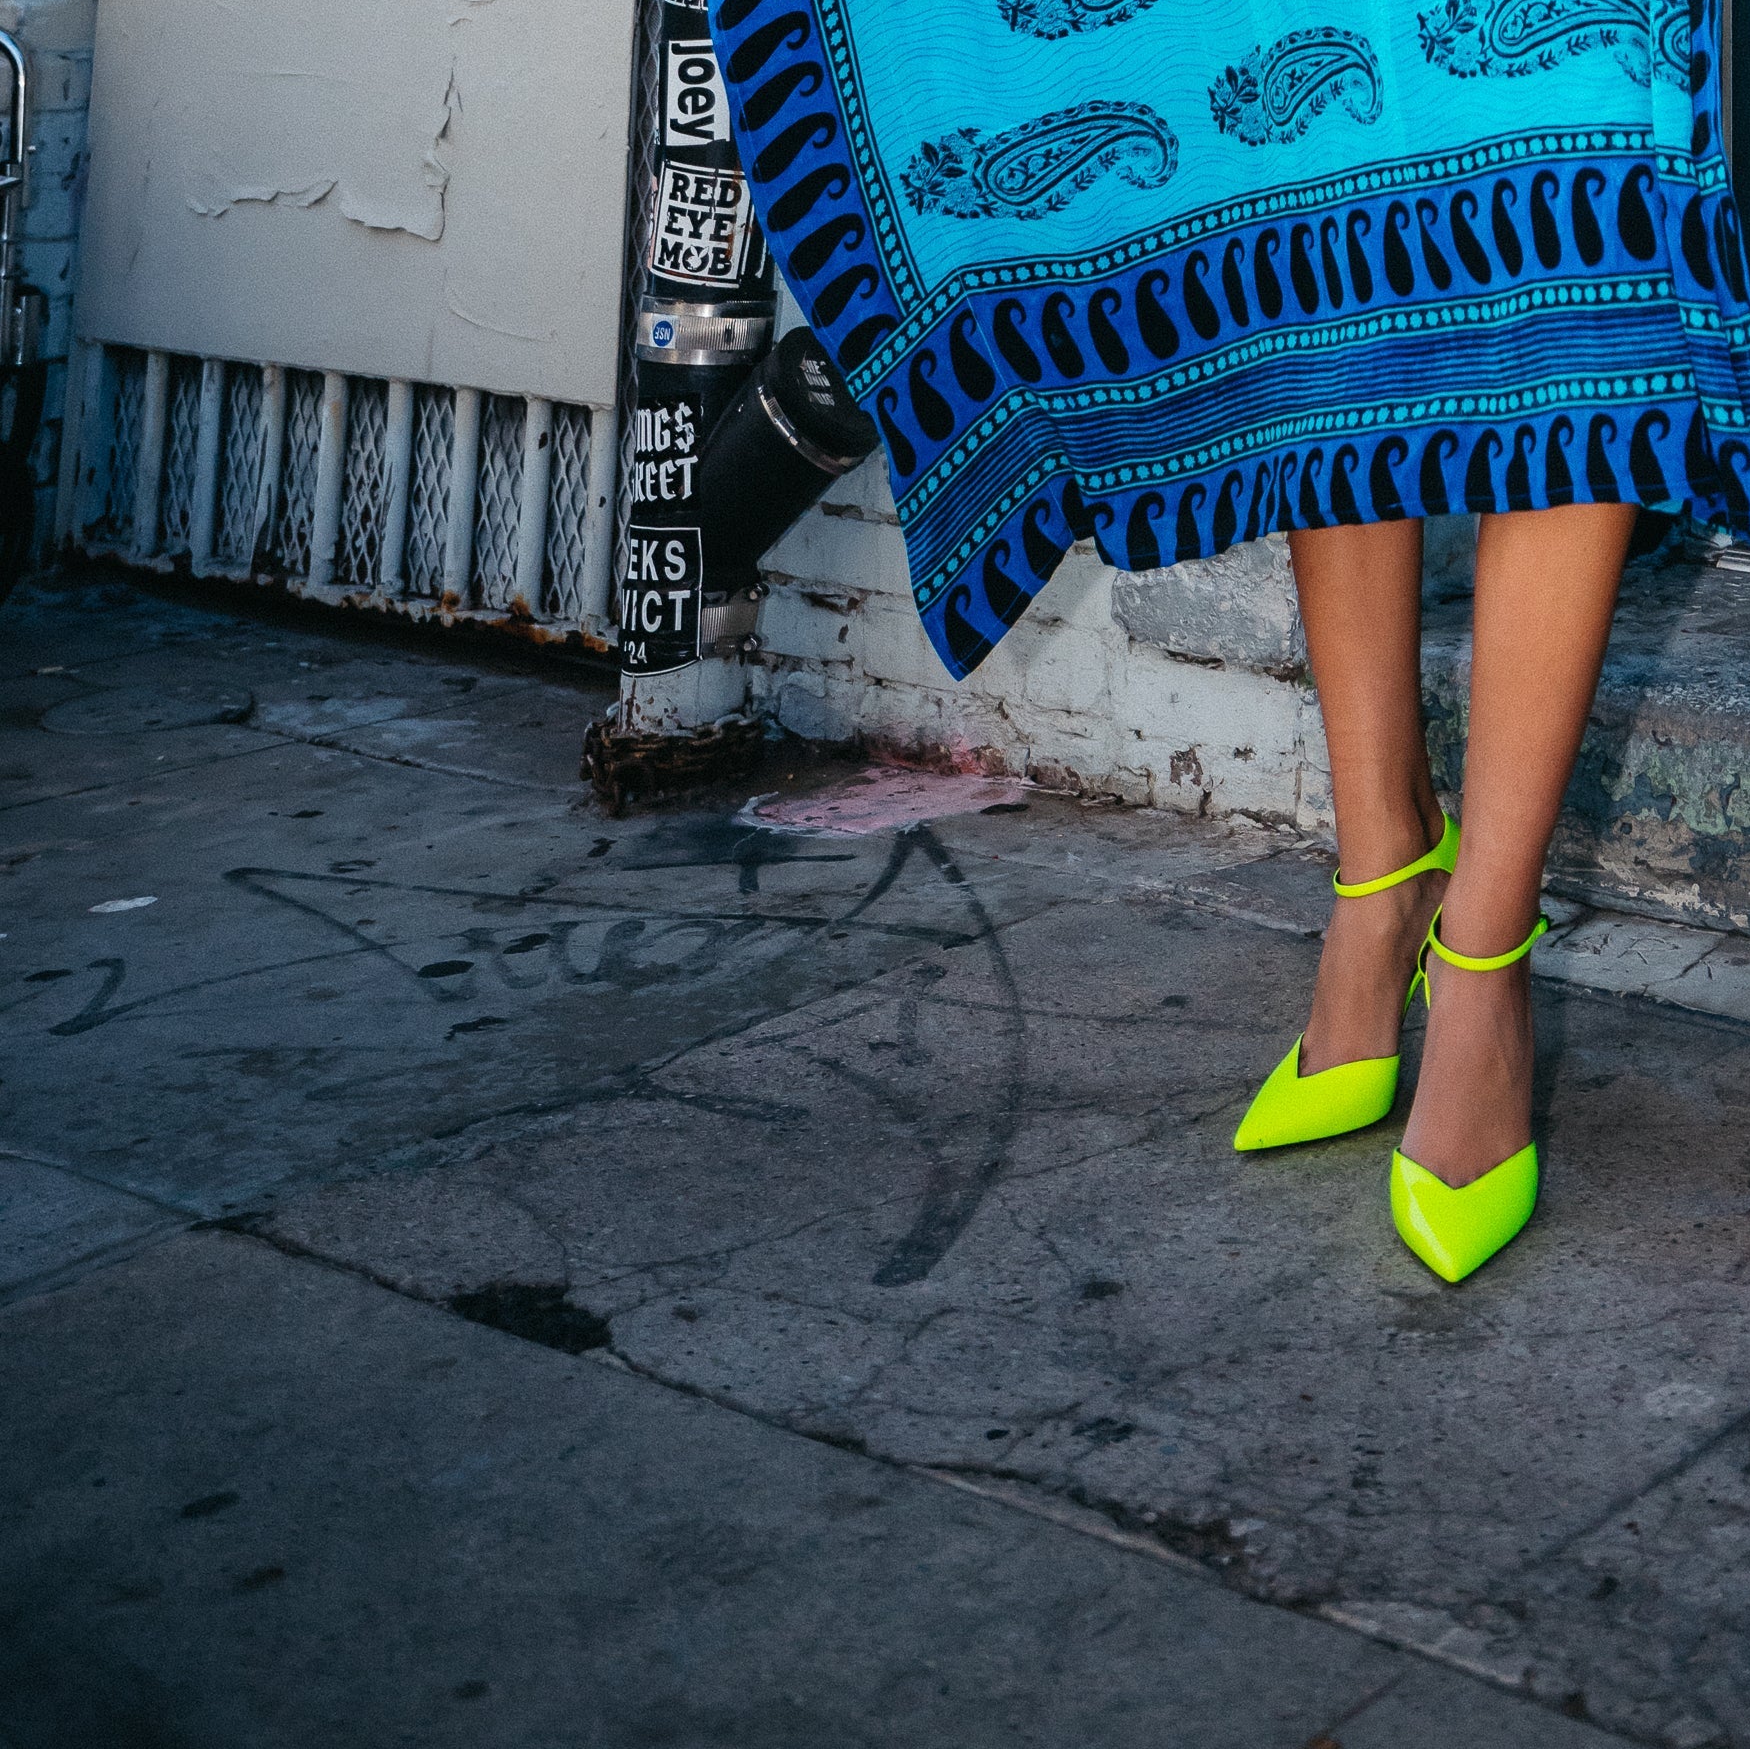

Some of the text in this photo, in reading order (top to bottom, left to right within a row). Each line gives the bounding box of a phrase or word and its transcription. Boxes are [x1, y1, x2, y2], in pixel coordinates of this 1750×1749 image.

[669, 42, 716, 141] Joey
[668, 171, 743, 210] RED
[664, 204, 737, 244] EYE
[657, 237, 733, 277] MOB
[654, 326, 671, 336] NSF
[627, 538, 687, 582] EKS
[623, 640, 648, 665] '24
